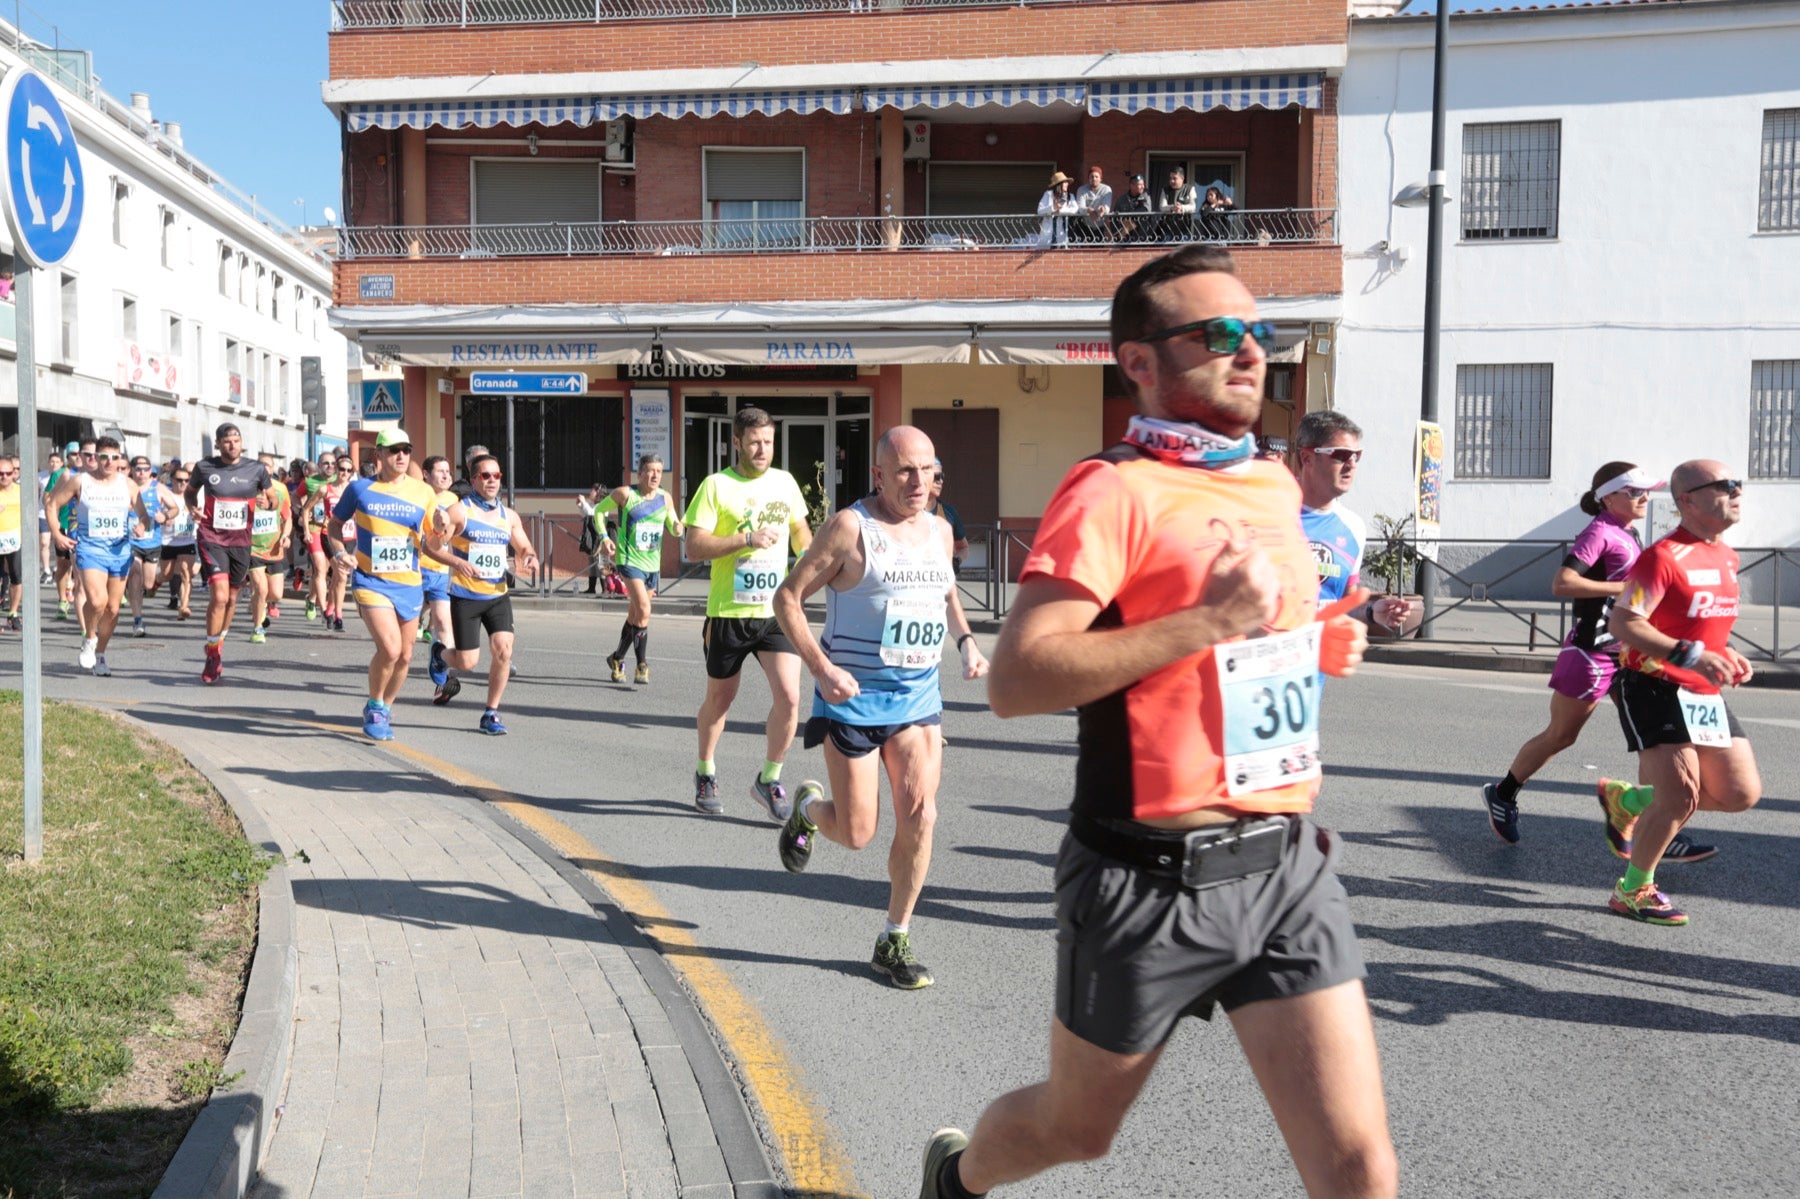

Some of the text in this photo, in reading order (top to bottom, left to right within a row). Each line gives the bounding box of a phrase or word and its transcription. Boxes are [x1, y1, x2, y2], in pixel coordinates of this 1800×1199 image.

[451, 343, 599, 362] RESTAURANTE
[766, 342, 855, 360] PARADA
[627, 362, 727, 378] BICHITOS
[473, 378, 564, 389] Granada A-44
[367, 502, 417, 514] agustinos
[95, 517, 119, 529] 396
[255, 516, 274, 528] 807
[378, 547, 408, 562] 483
[474, 554, 501, 569] 498
[743, 572, 778, 590] 960
[882, 570, 950, 584] MARACENA
[889, 619, 945, 646] 1083
[1250, 675, 1314, 741] 30
[1685, 703, 1720, 728] 724
